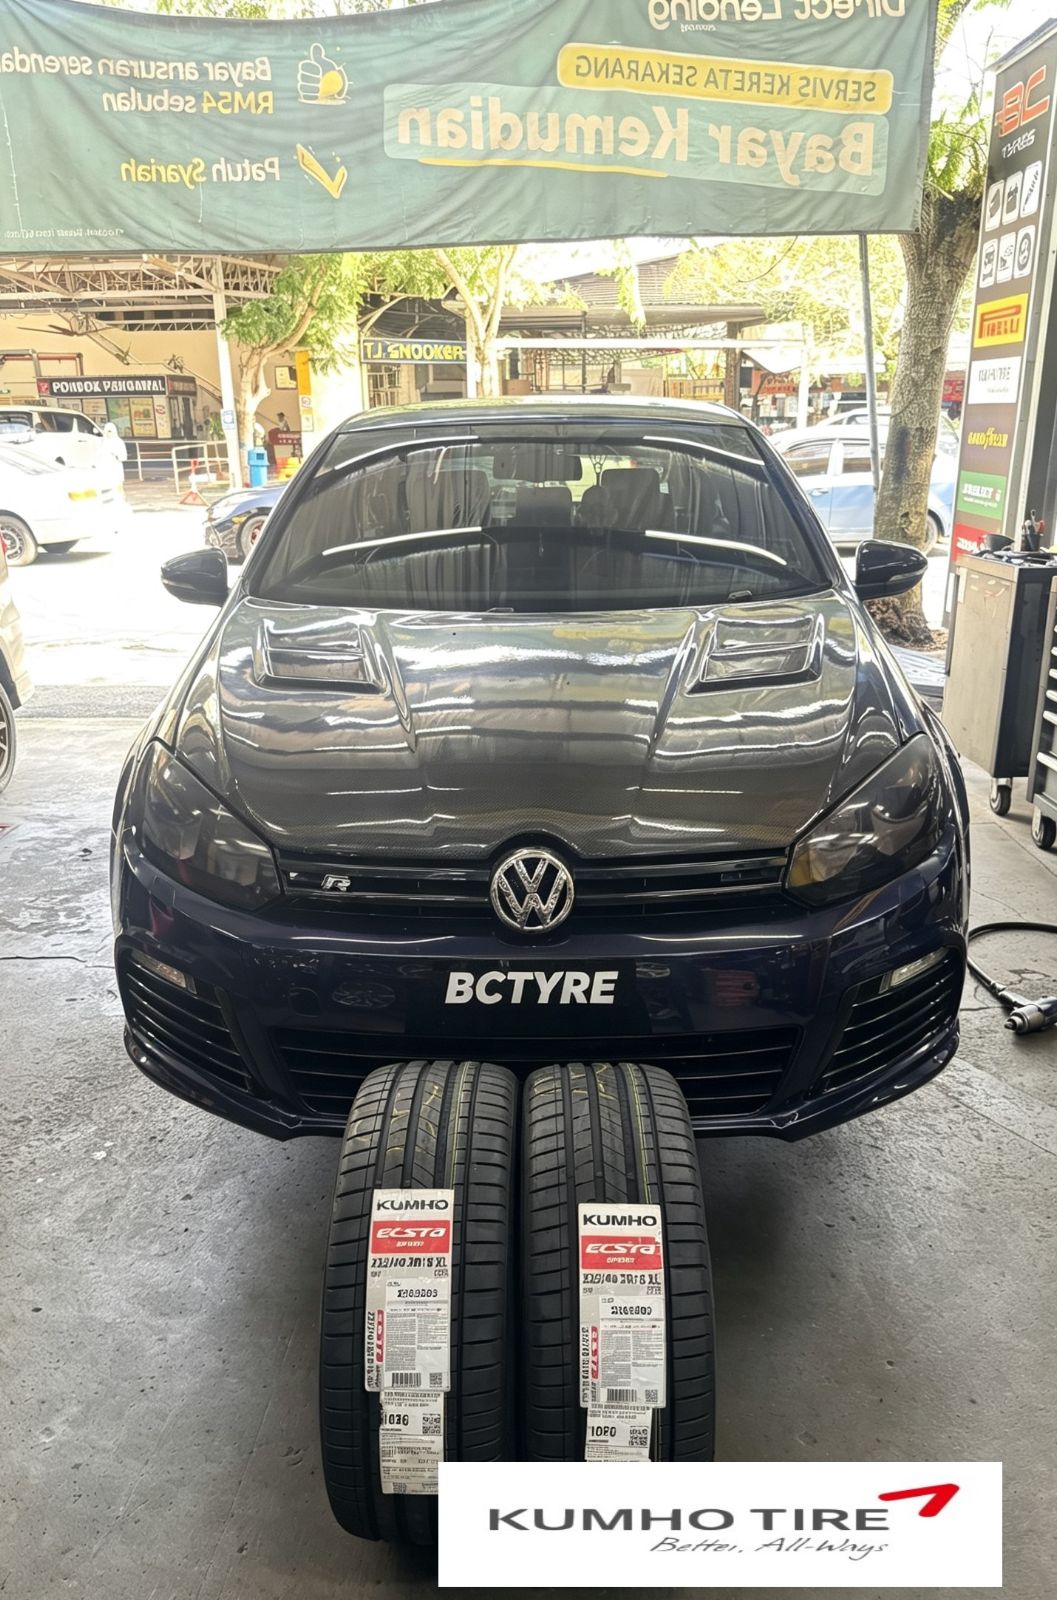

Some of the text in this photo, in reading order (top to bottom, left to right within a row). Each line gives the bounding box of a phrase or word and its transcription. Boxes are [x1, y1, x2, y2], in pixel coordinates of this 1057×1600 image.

[387, 342, 464, 361] SNOOKER
[445, 970, 619, 1006] BCTYRE
[377, 1199, 449, 1211] KUMHO
[583, 1213, 657, 1227] KUMHO
